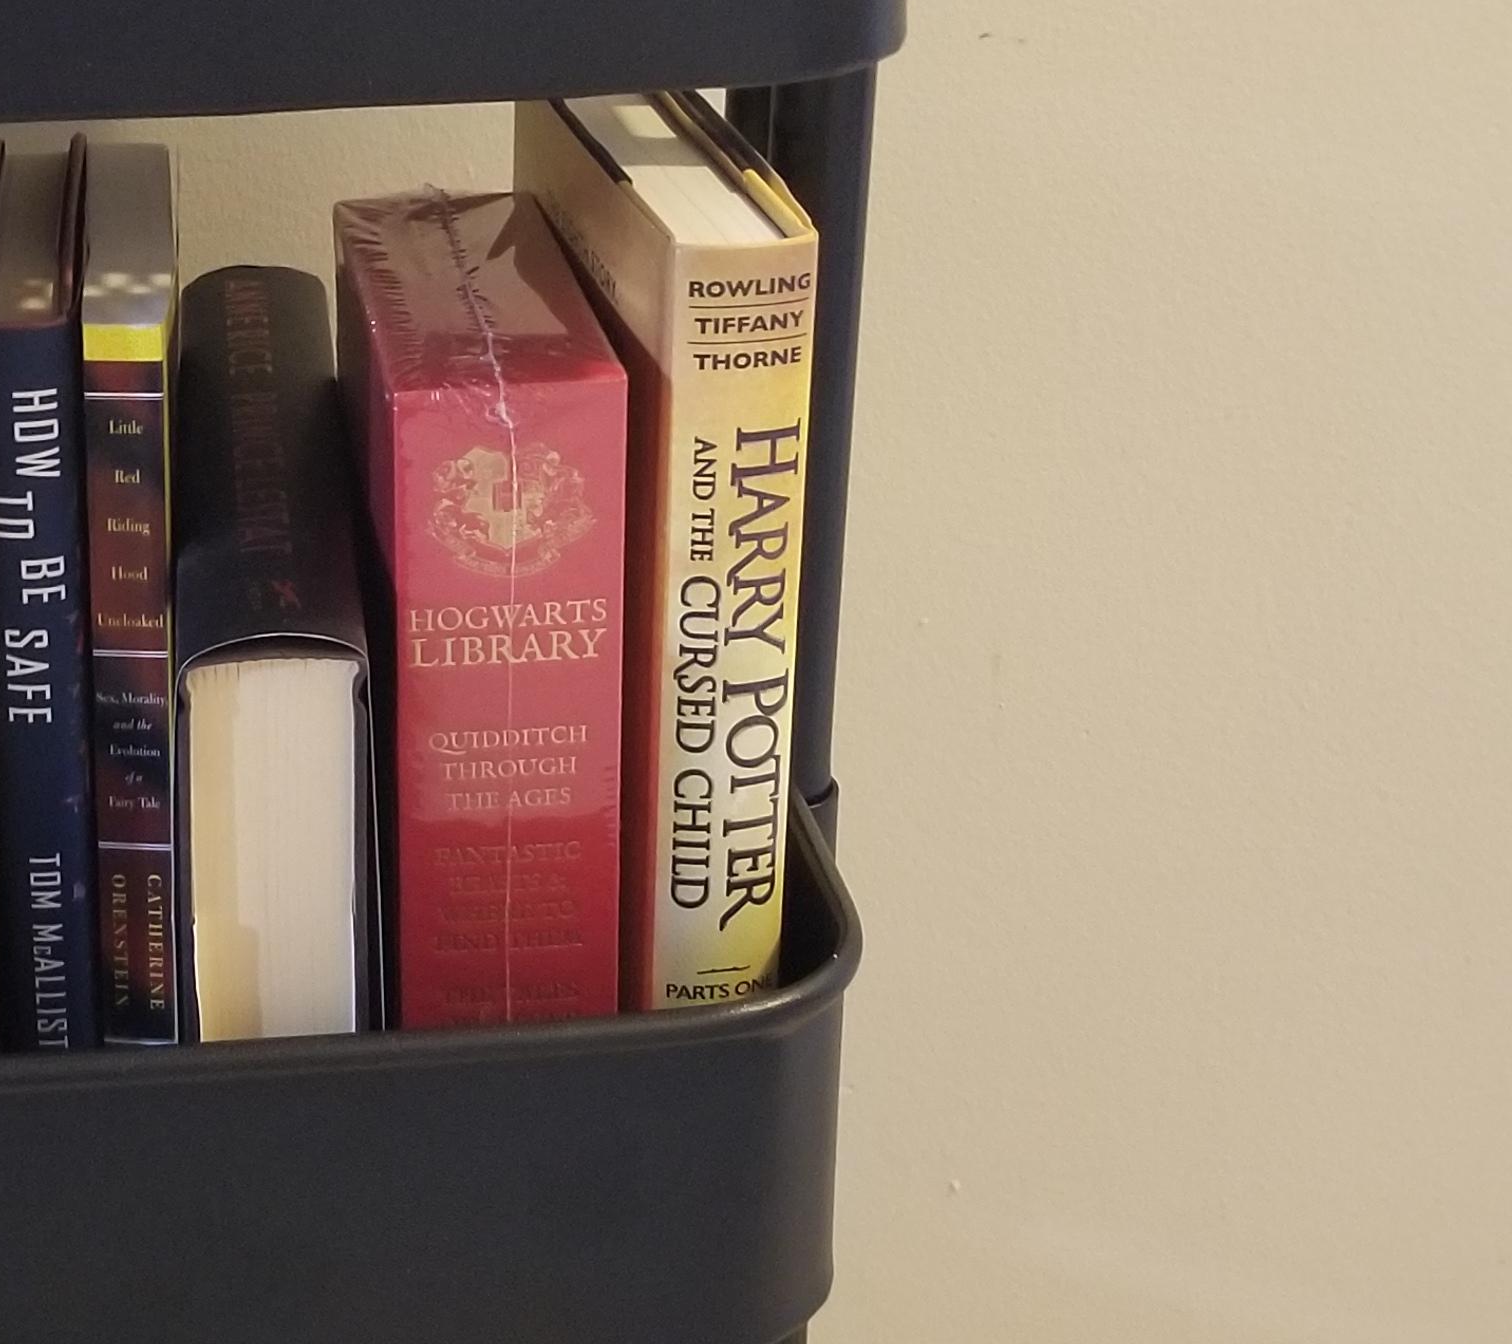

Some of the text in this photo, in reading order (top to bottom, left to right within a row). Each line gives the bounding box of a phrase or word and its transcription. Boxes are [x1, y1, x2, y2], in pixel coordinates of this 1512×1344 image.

[688, 271, 813, 299] ROWLING
[694, 308, 806, 336] TIFFANY
[692, 344, 804, 372] THORNE
[11, 387, 62, 480] HOW
[108, 418, 145, 437] Little
[114, 468, 142, 486] Red
[106, 516, 152, 537] Riding
[20, 555, 68, 605] BE
[110, 566, 149, 583] Hood
[96, 611, 166, 630] Uncloaked
[407, 597, 609, 635] HOGWARTS
[410, 625, 611, 669] LIBRARY
[3, 628, 54, 724] SAFE
[669, 434, 724, 911] AND THE CURSED CHILD
[718, 416, 803, 933] HARRY POTTER
[120, 690, 168, 709] Morality,
[108, 742, 162, 759] Evolution
[427, 724, 590, 757] QUIDDITCH
[441, 755, 579, 783] THROUGH
[137, 794, 162, 810] Tale
[448, 785, 574, 812] THE AGES
[28, 852, 63, 911] TOM
[110, 872, 130, 1007] ORENSTEIN
[146, 872, 166, 1011] CATHERINE
[664, 981, 732, 1001] PARTS
